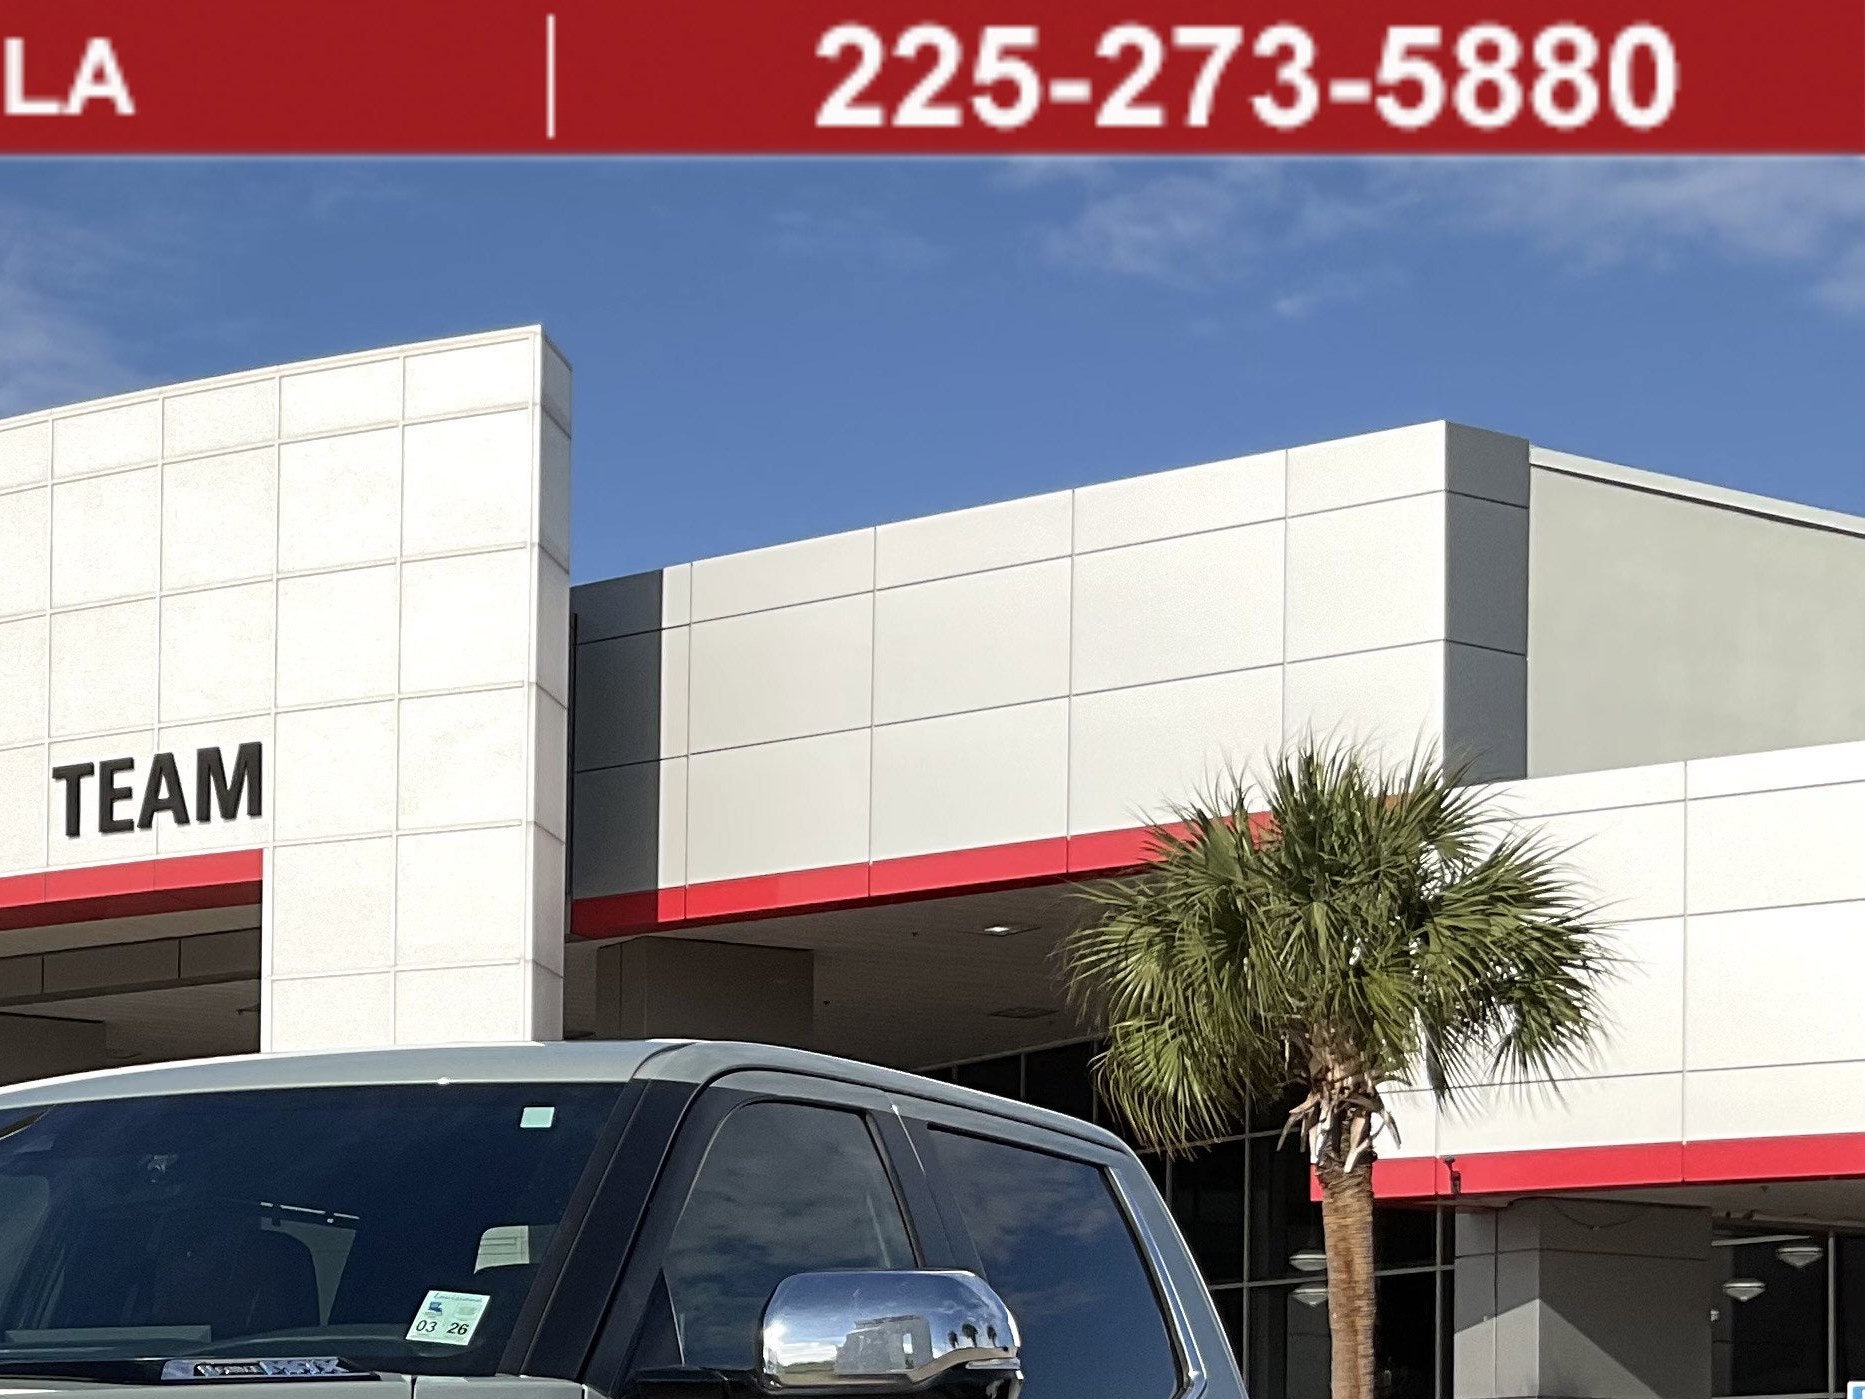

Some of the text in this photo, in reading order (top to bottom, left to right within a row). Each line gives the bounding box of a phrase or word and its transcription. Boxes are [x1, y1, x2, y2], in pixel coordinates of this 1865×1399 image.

[51, 740, 264, 839] TEAM
[416, 1320, 469, 1335] 03 26
